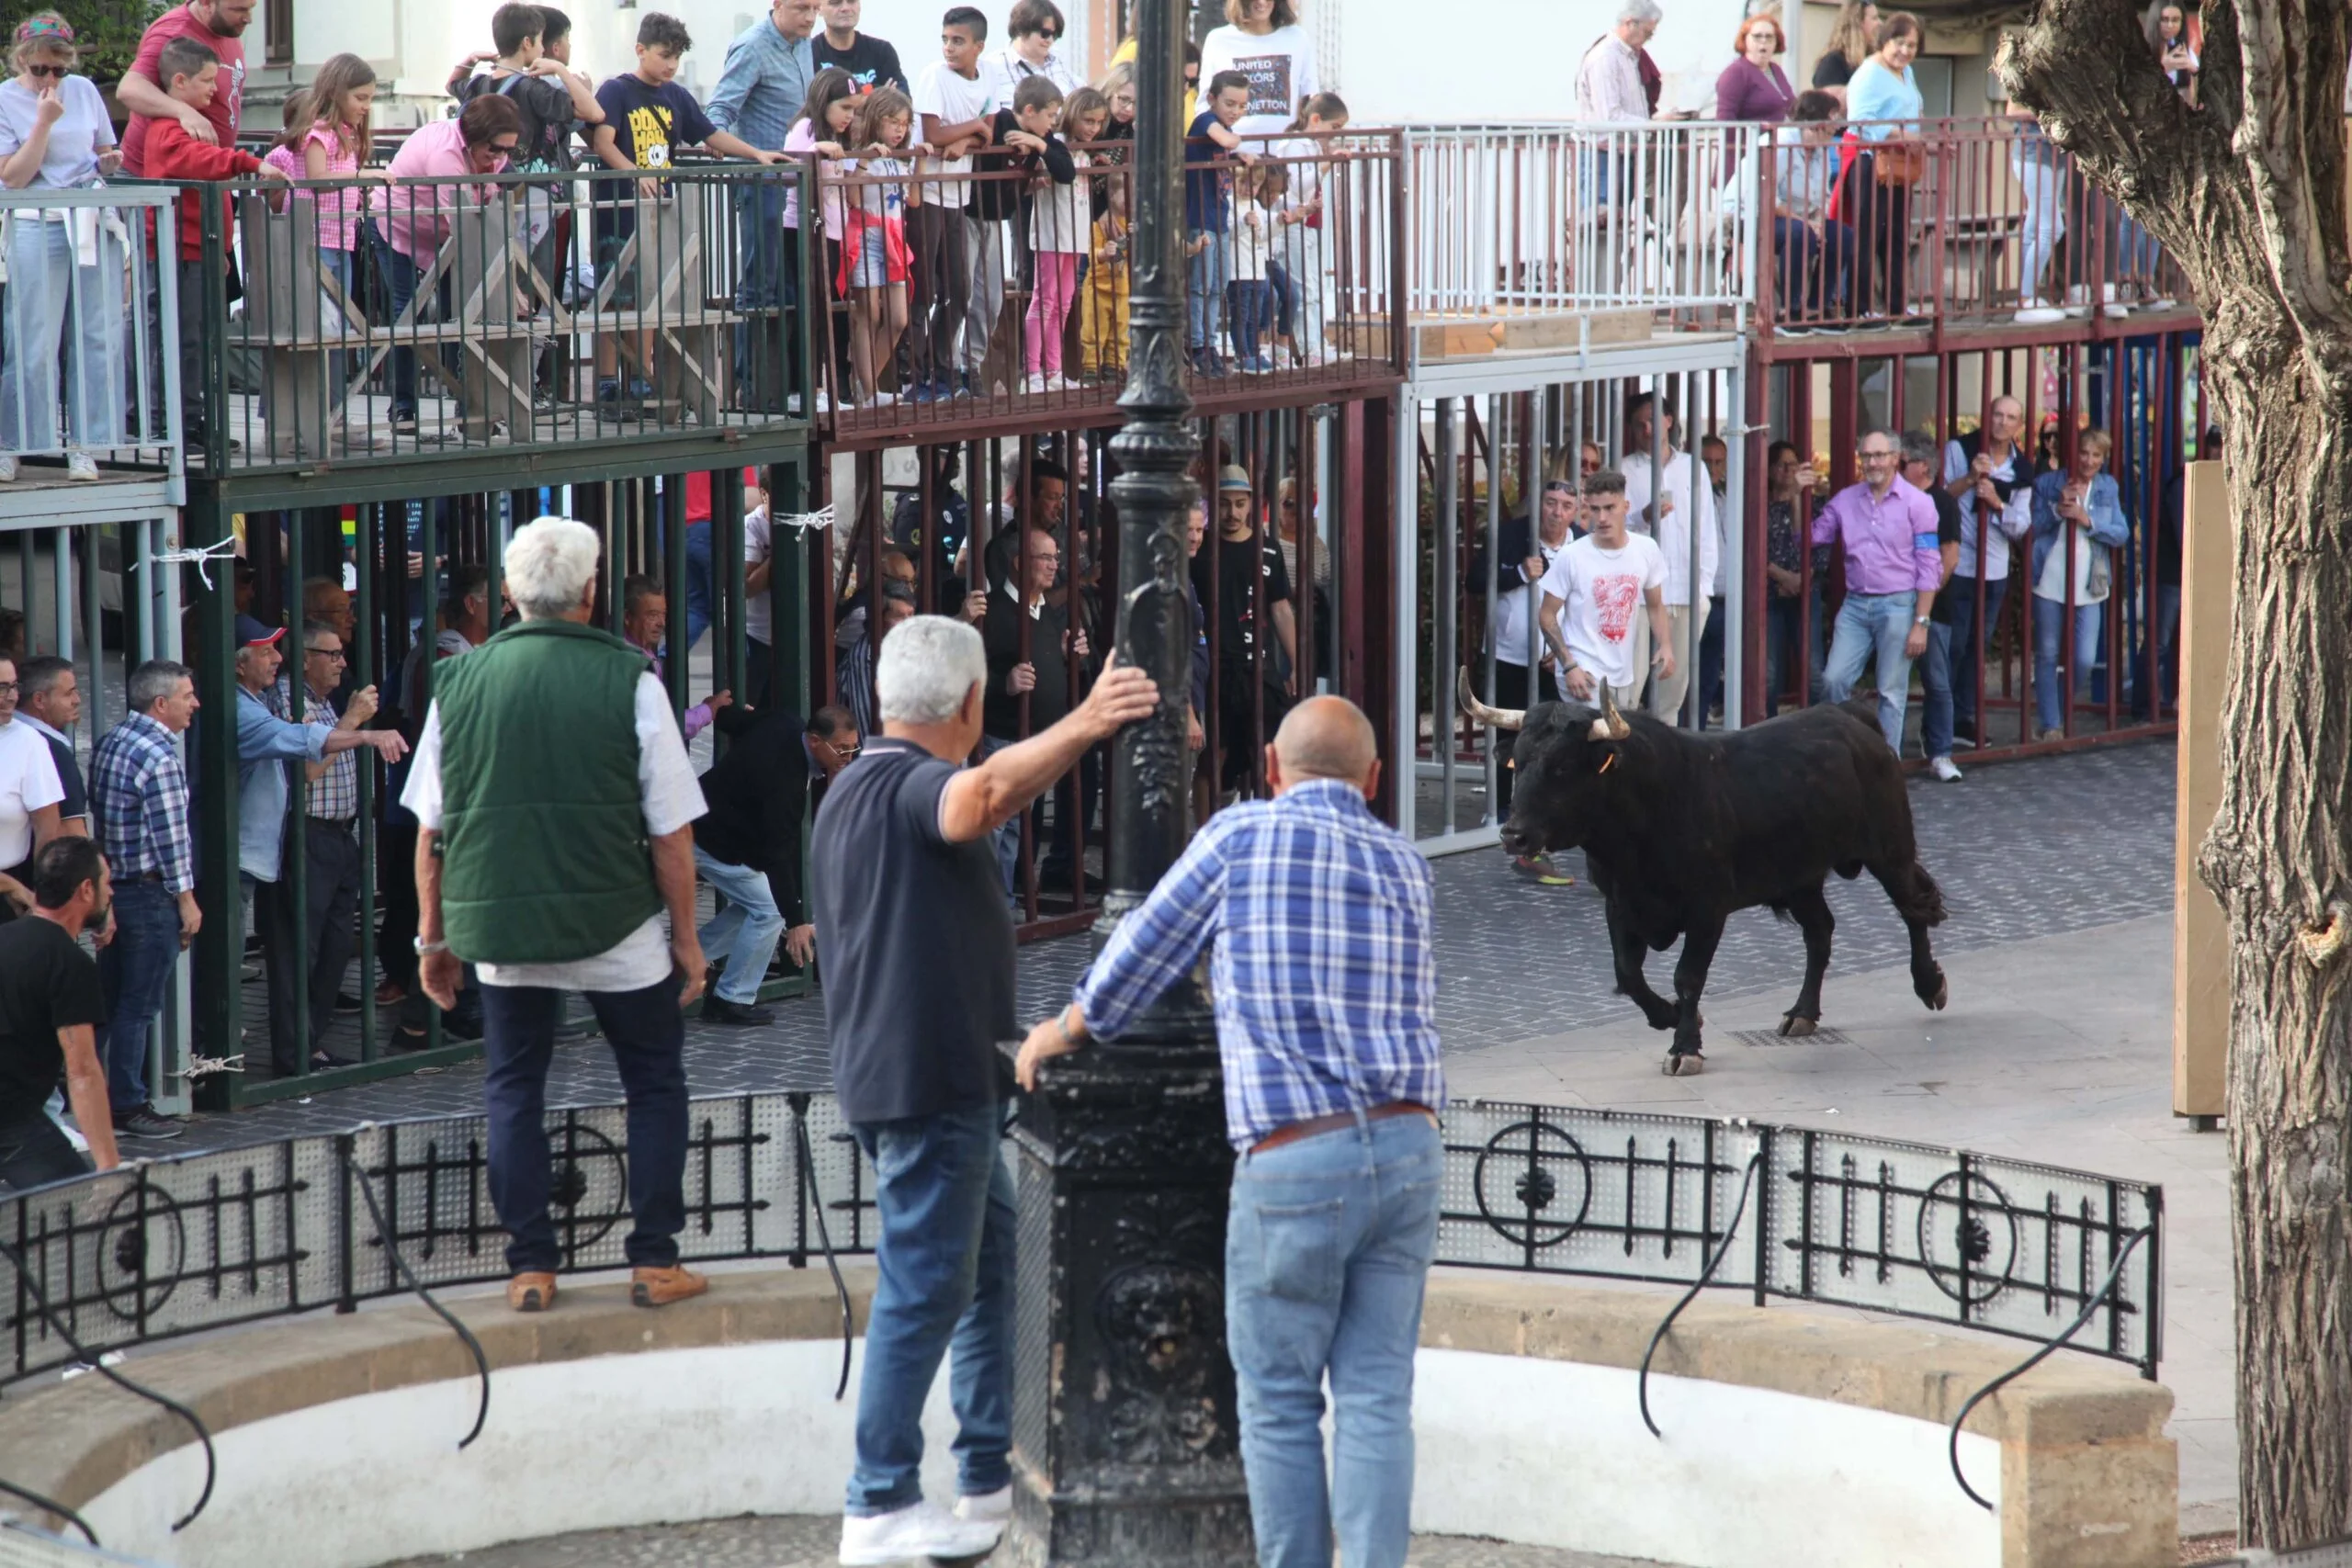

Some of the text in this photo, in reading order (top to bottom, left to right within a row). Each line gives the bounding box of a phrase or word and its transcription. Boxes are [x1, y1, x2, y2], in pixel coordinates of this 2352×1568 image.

[1232, 60, 1272, 72] UNITED
[1242, 73, 1275, 84] LORS
[1245, 100, 1287, 110] NETTON
